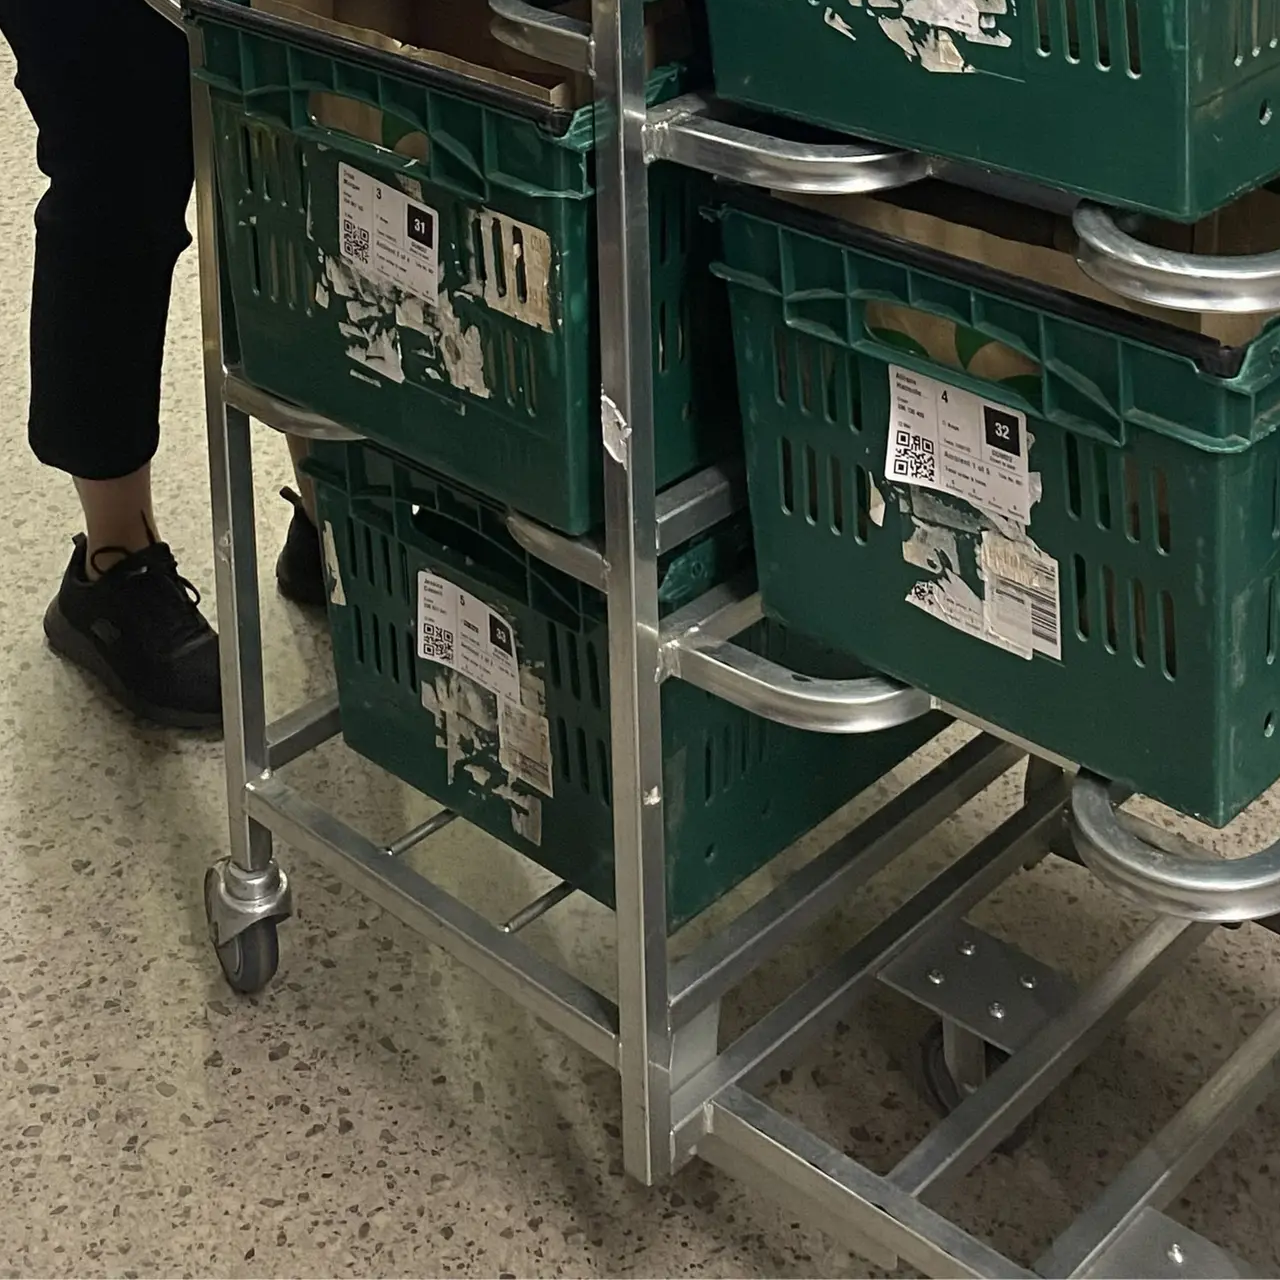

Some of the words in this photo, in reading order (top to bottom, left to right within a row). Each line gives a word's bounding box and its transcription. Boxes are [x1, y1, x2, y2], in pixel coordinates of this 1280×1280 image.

[376, 187, 382, 200] 3
[414, 218, 426, 235] 31
[941, 389, 949, 403] 4
[994, 422, 1010, 440] 32
[459, 594, 466, 606] 5
